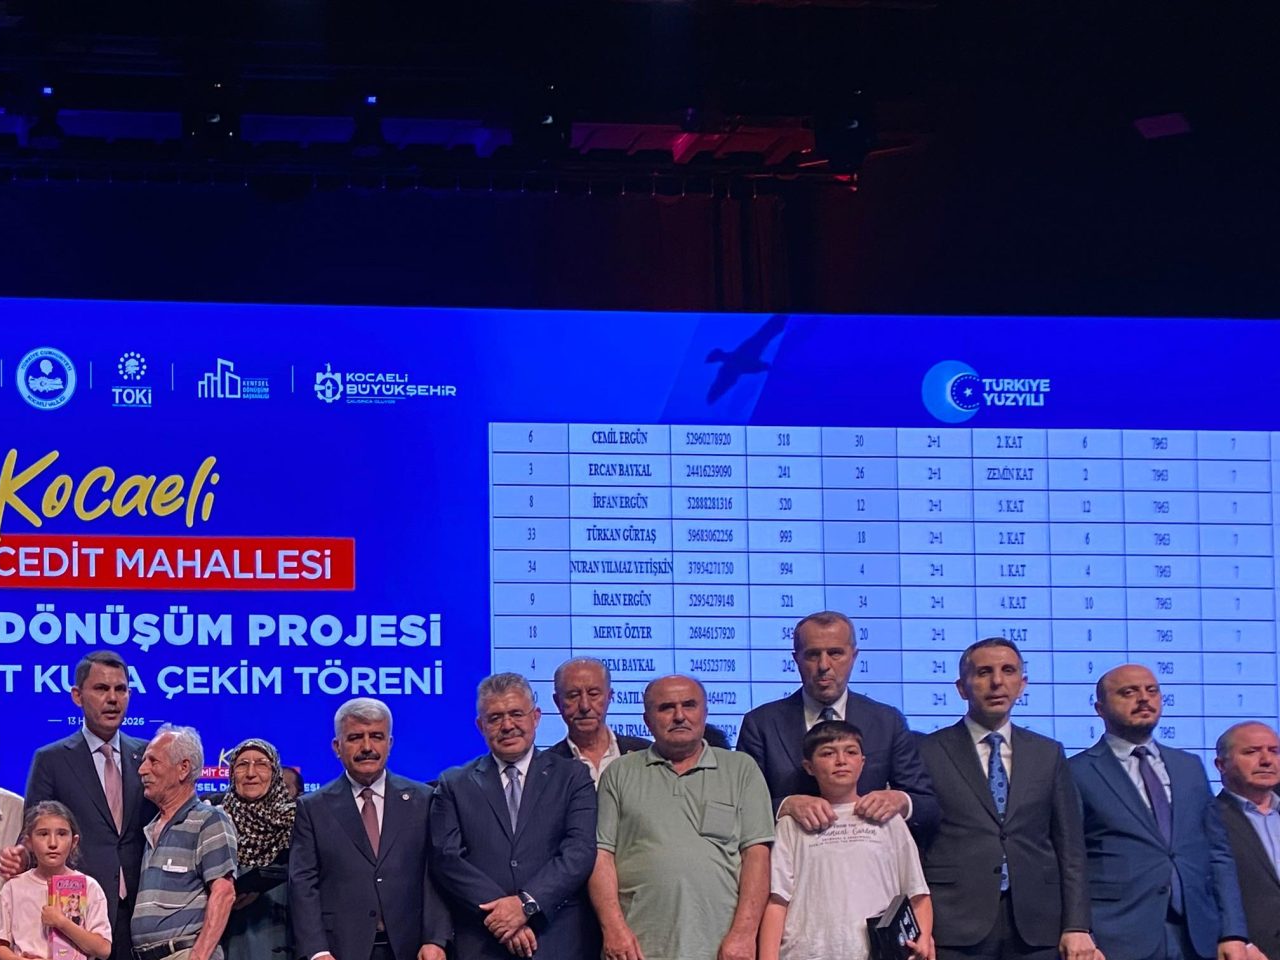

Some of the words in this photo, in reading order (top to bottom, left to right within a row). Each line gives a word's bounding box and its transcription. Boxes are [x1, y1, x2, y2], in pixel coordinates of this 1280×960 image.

[528, 431, 533, 443] 6
[592, 428, 617, 444] CEMİL
[619, 428, 648, 445] ERGÜN
[686, 432, 731, 445] 52960278920
[778, 433, 790, 446] 518
[855, 435, 864, 447] 30
[928, 435, 940, 448] 2+1
[997, 436, 1004, 448] 2.
[1005, 436, 1023, 448] KAT
[1083, 437, 1088, 449] 6
[529, 463, 533, 475] 3
[589, 464, 617, 477] ERCAN
[618, 464, 652, 477] BAYKAL
[686, 465, 732, 477] 24416239090
[778, 465, 791, 478] 241
[856, 467, 864, 479] 26
[928, 467, 941, 480] 2+1
[987, 468, 1015, 480] ZEMİN
[1016, 468, 1033, 481] KAT
[1083, 469, 1088, 481] 2
[529, 496, 533, 508] 8
[593, 493, 618, 508] İRFAN
[619, 493, 648, 509] ERGÜN
[688, 497, 732, 510] 52888281316
[779, 498, 792, 511] 520
[857, 499, 865, 512] 12
[929, 499, 942, 512] 2+1
[998, 500, 1005, 512] 5.
[1006, 500, 1024, 513] KAT
[1083, 501, 1091, 513] 12
[528, 528, 536, 540] 33
[586, 525, 620, 541] TÜRKAN
[623, 525, 656, 544] GÜRTAŞ
[688, 529, 733, 542] 59683062256
[780, 530, 792, 543] 993
[858, 531, 866, 544] 18
[930, 531, 943, 544] 2+1
[999, 532, 1006, 544] 2.
[1007, 532, 1025, 545] KAT
[1085, 532, 1090, 545] 6
[528, 560, 536, 573] 34
[570, 560, 599, 574] NURAN
[601, 560, 634, 574] YILMAZ
[634, 558, 673, 576] YETİŞKİN
[689, 561, 733, 575] 37954271750
[780, 562, 793, 575] 994
[860, 563, 864, 575] 4
[930, 564, 943, 577] 2+1
[1000, 564, 1007, 577] 1.
[1008, 565, 1026, 577] KAT
[1086, 565, 1090, 577] 4
[530, 593, 535, 605] 9
[593, 590, 621, 606] İMRAN
[623, 590, 651, 606] ERGÜN
[689, 593, 734, 607] 52954279148
[781, 595, 794, 608] 521
[859, 596, 867, 609] 34
[931, 596, 944, 609] 2+1
[1000, 596, 1008, 609] 4.
[1009, 597, 1027, 609] KAT
[1085, 597, 1093, 609] 10
[529, 626, 537, 638] 18
[594, 626, 621, 639] MERVE
[624, 623, 652, 639] ÖZYER
[690, 627, 735, 640] 26846157920
[782, 627, 794, 640] 543
[860, 628, 868, 641] 20
[932, 629, 945, 641] 2+1
[1010, 629, 1028, 642] KAT
[1088, 629, 1092, 642] 8
[531, 658, 535, 670] 4
[622, 659, 655, 672] BAYKAL
[691, 659, 736, 672] 24455237798
[782, 660, 795, 672] 242
[860, 660, 868, 673] 21
[933, 661, 946, 673] 2+1
[1088, 662, 1093, 674] 9
[35, 664, 144, 695] KUA
[157, 659, 298, 701] ÇEKİM
[302, 660, 444, 696] TÖRENİ
[933, 694, 947, 706] 2+1
[68, 716, 76, 725] 13
[122, 717, 144, 726] 2026
[1090, 727, 1094, 739] 8
